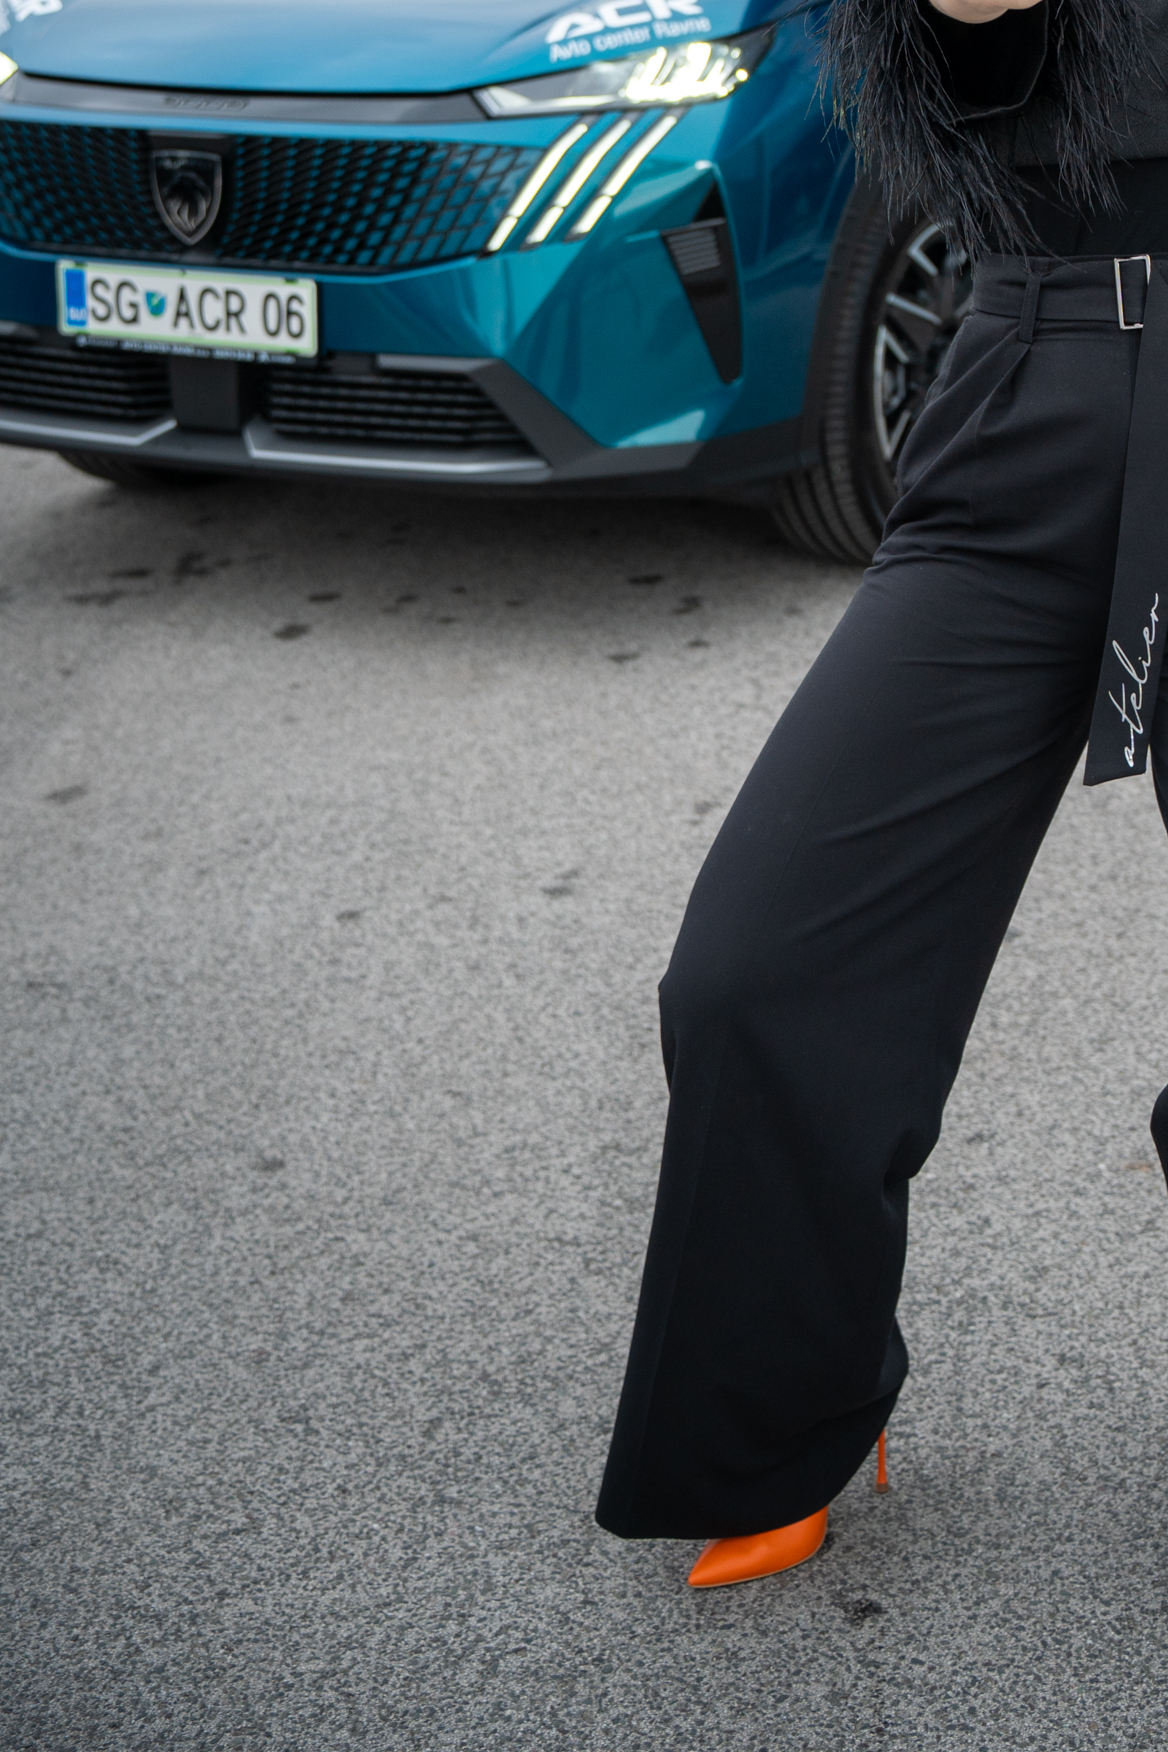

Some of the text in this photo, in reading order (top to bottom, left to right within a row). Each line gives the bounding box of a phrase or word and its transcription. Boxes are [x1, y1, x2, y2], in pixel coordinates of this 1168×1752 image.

[550, 38, 591, 63] Avto
[593, 25, 651, 52] center
[90, 278, 305, 339] SG ACR 06
[1108, 593, 1159, 768] atelier
